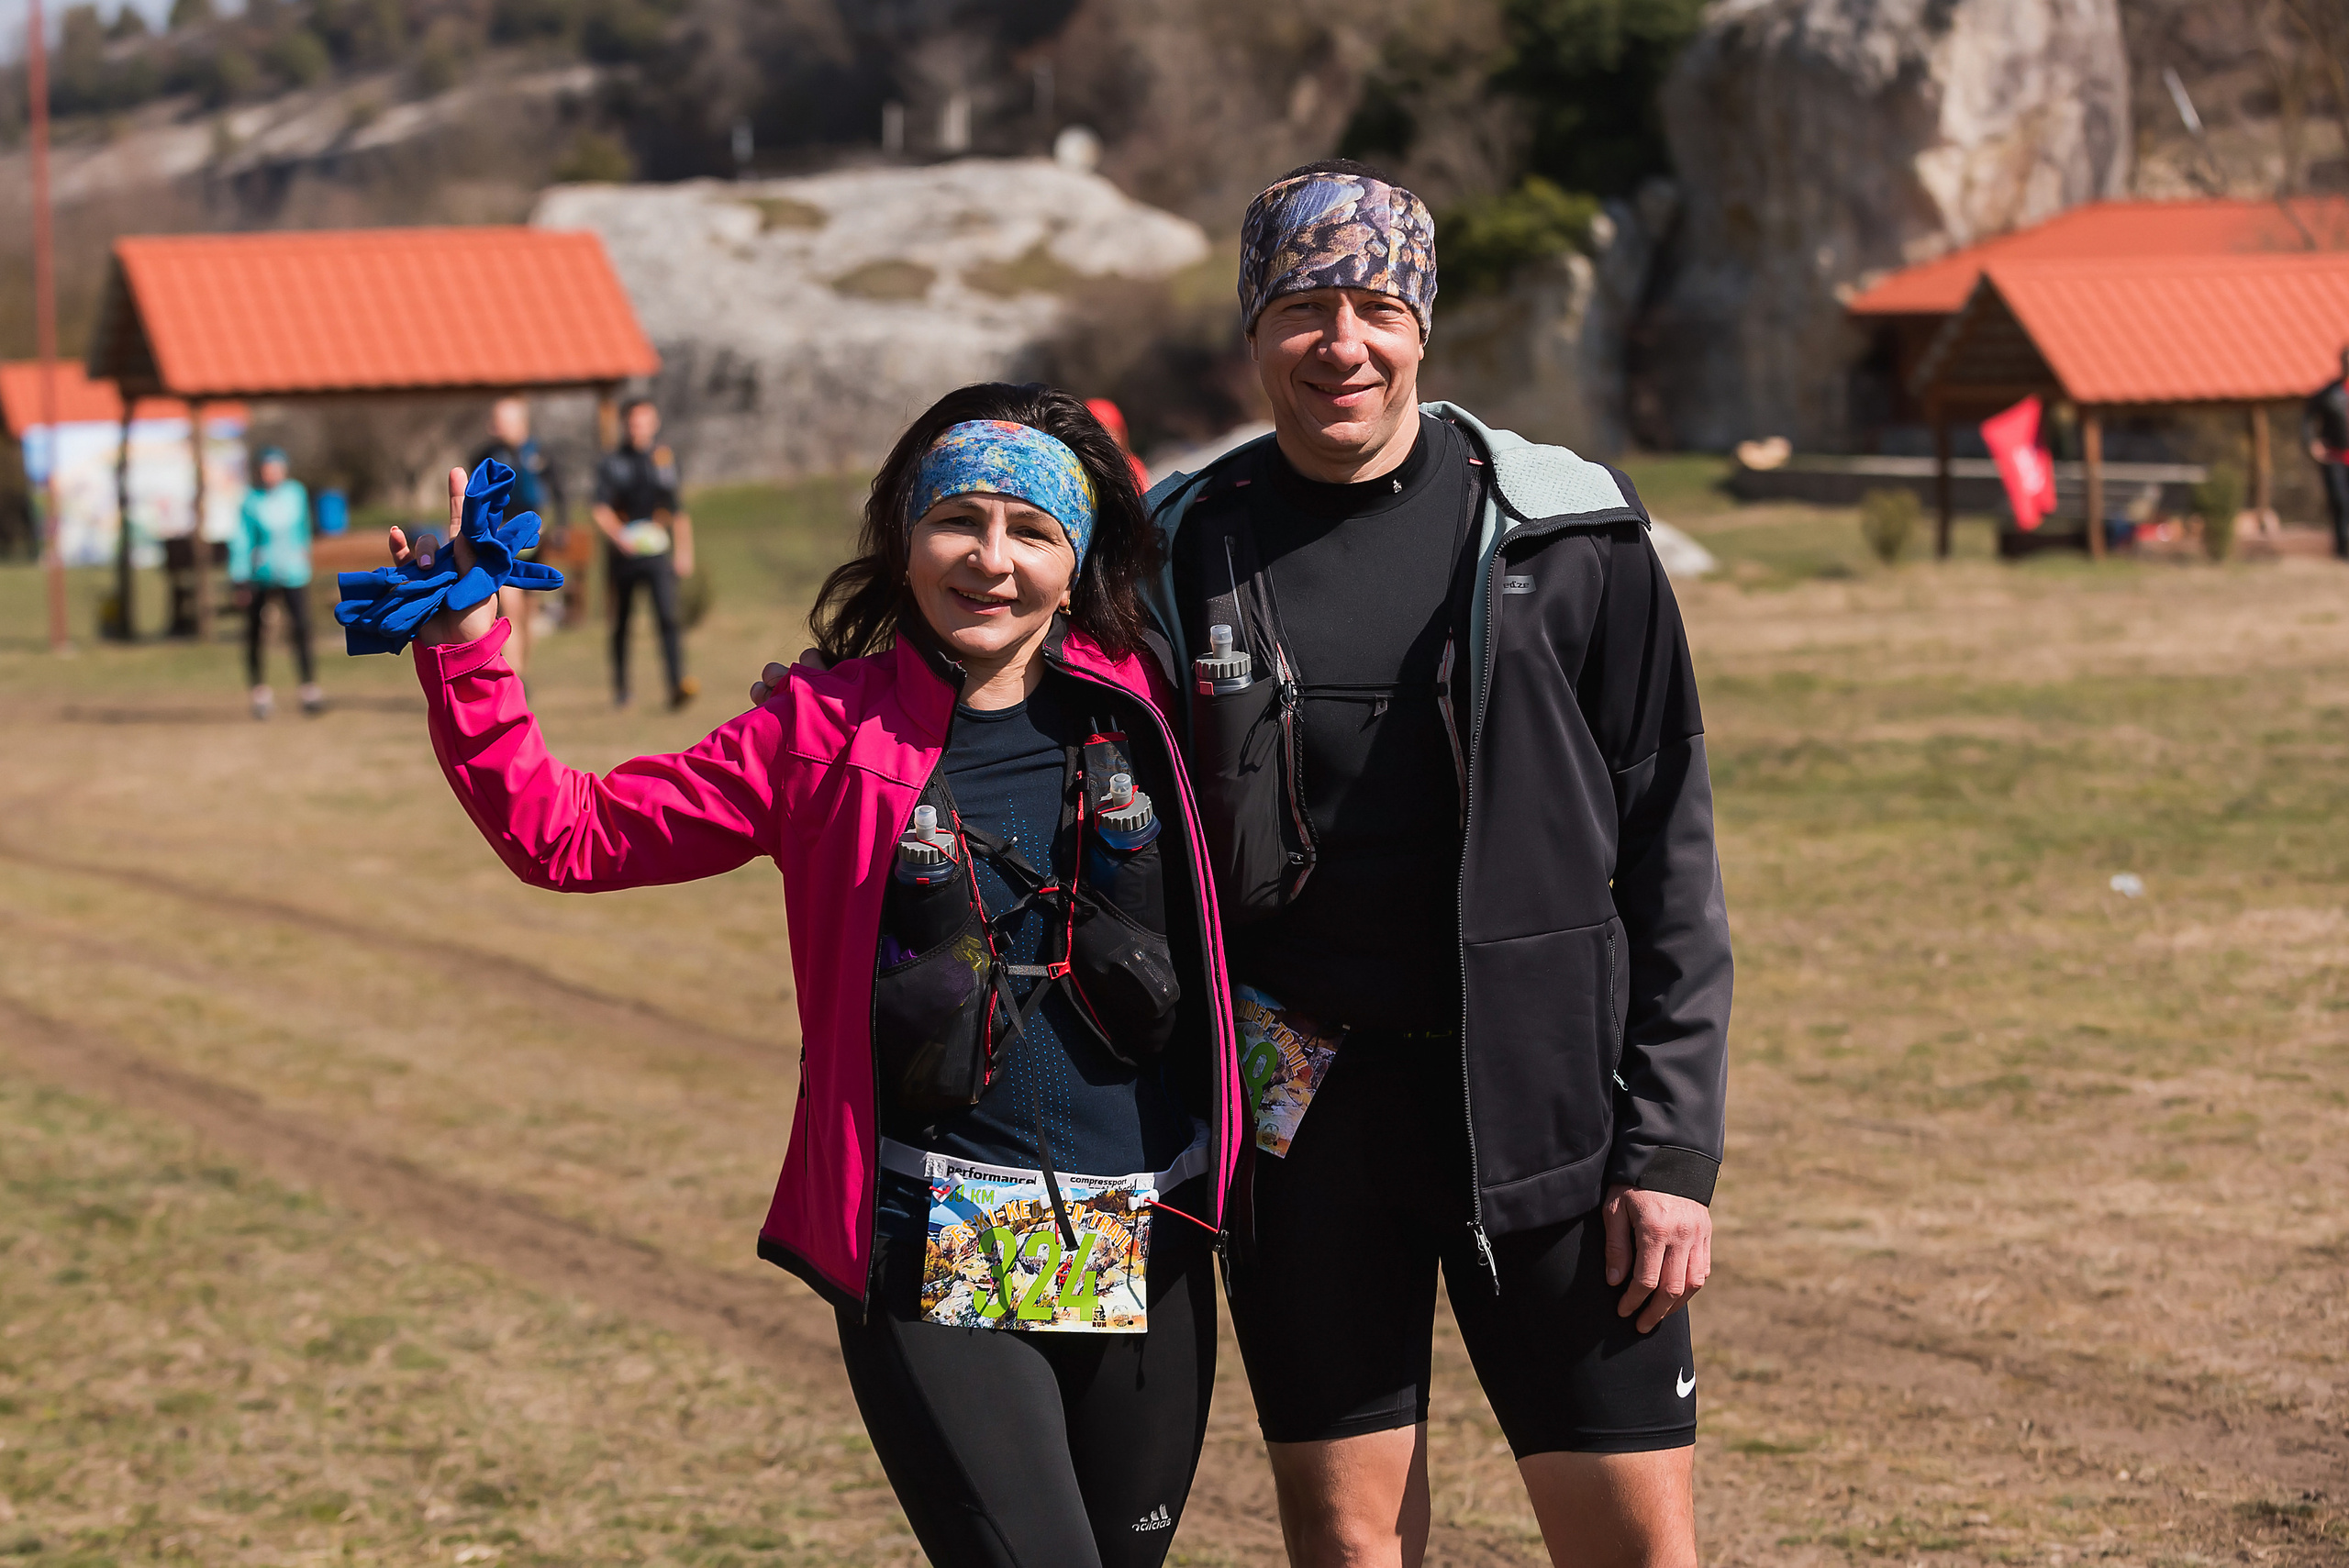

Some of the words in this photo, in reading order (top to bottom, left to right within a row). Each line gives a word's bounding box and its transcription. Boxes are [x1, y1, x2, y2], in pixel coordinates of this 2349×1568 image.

[1272, 1022, 1308, 1075] TRAIL
[971, 1188, 995, 1205] KM
[1070, 1176, 1127, 1188] compressport
[1089, 1208, 1133, 1255] TRAIL
[974, 1227, 1098, 1321] 324
